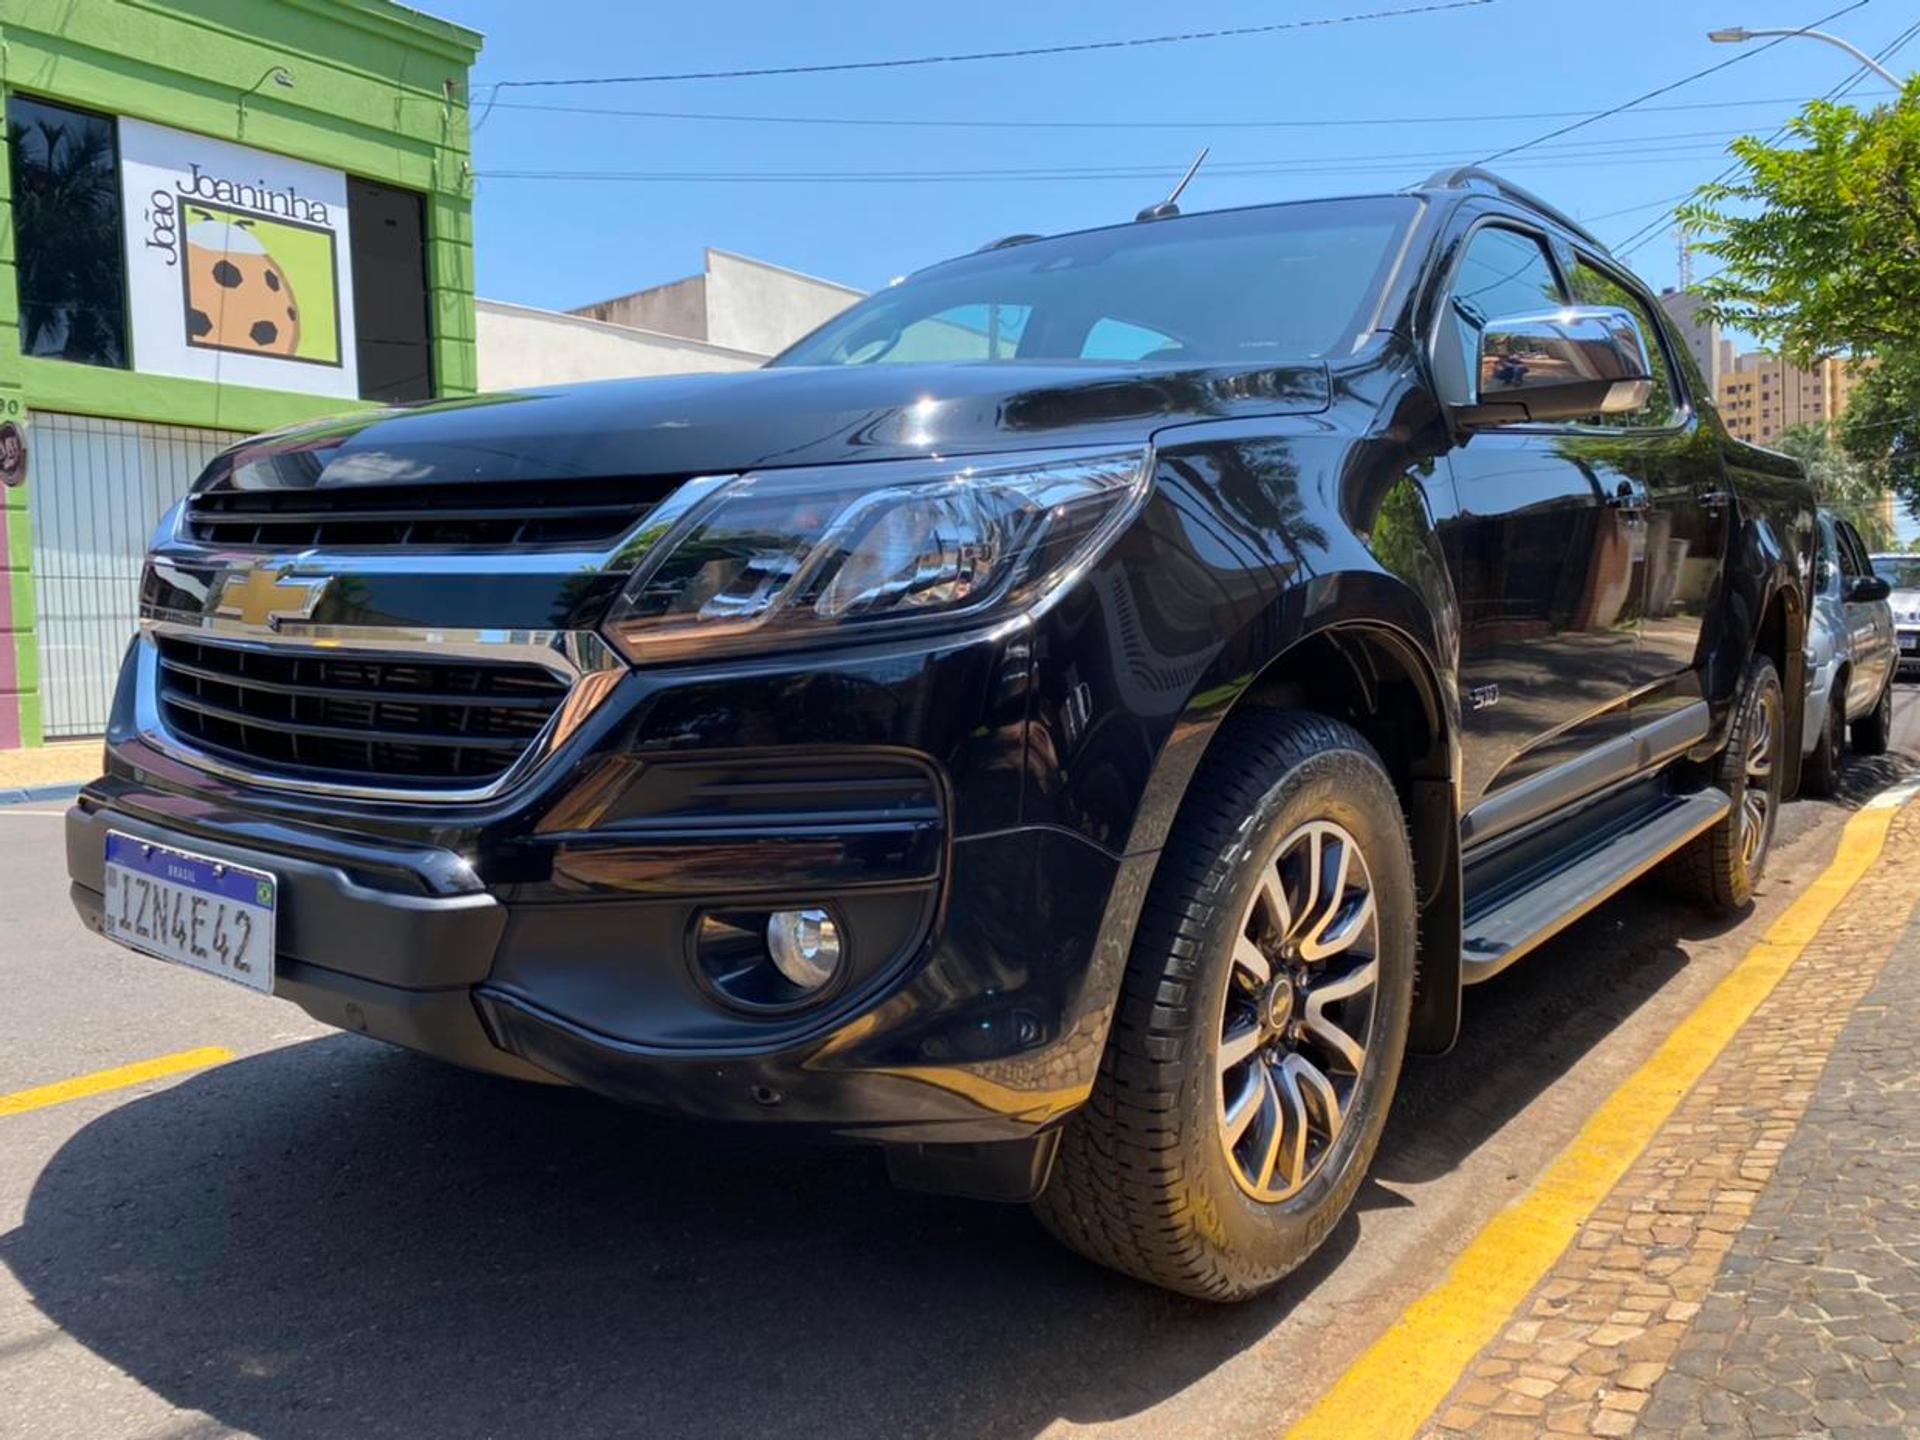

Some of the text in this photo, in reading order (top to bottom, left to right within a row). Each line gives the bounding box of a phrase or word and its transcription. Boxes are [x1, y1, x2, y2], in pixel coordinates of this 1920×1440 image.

[145, 190, 177, 265] João
[176, 163, 331, 225] Joaninha
[168, 864, 196, 882] BRASIL
[119, 874, 251, 973] IZN4E42
